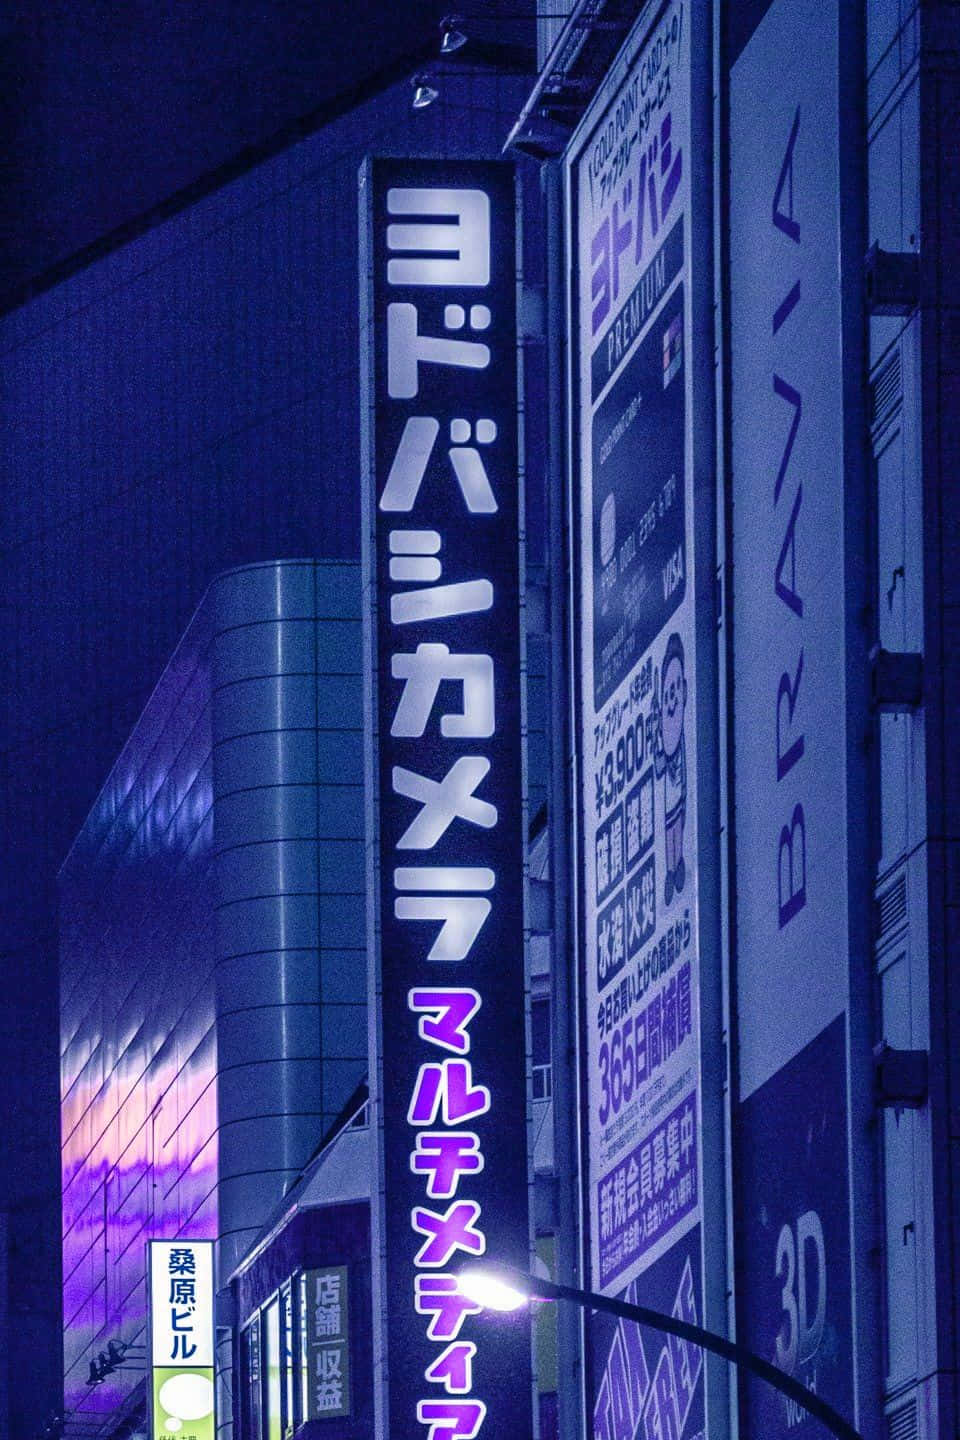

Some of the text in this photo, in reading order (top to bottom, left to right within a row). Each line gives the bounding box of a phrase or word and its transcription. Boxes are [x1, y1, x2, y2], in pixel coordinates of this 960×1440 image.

[591, 112, 682, 336] ヨドバシ
[607, 252, 666, 372] PREMIUM
[379, 187, 499, 962] ヨドバシカメラ
[773, 103, 807, 930] BRAVIA
[168, 1248, 197, 1361] 桑原ビル
[315, 1274, 341, 1338] 店舗
[775, 1210, 827, 1375] 3D
